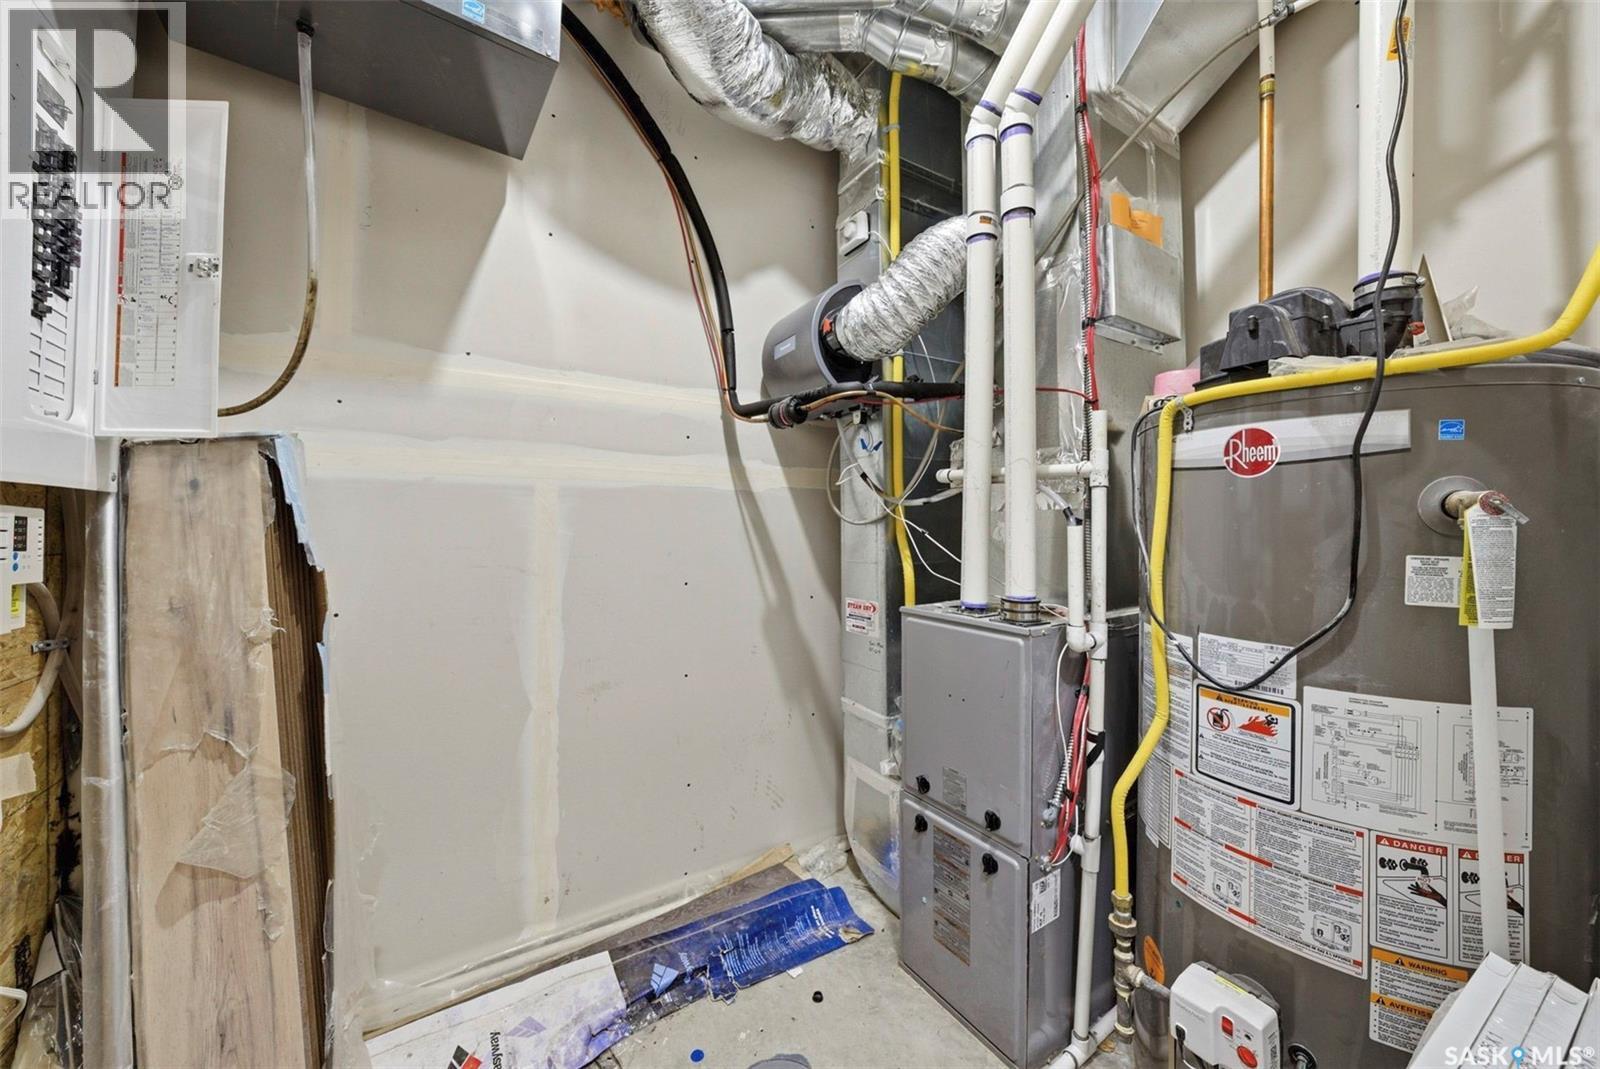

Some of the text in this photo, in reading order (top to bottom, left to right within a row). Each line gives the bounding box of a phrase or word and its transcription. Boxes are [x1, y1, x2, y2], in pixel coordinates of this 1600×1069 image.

[1223, 429, 1278, 469] Rheem
[1393, 839, 1444, 855] DANGER
[1408, 961, 1448, 976] WARNING
